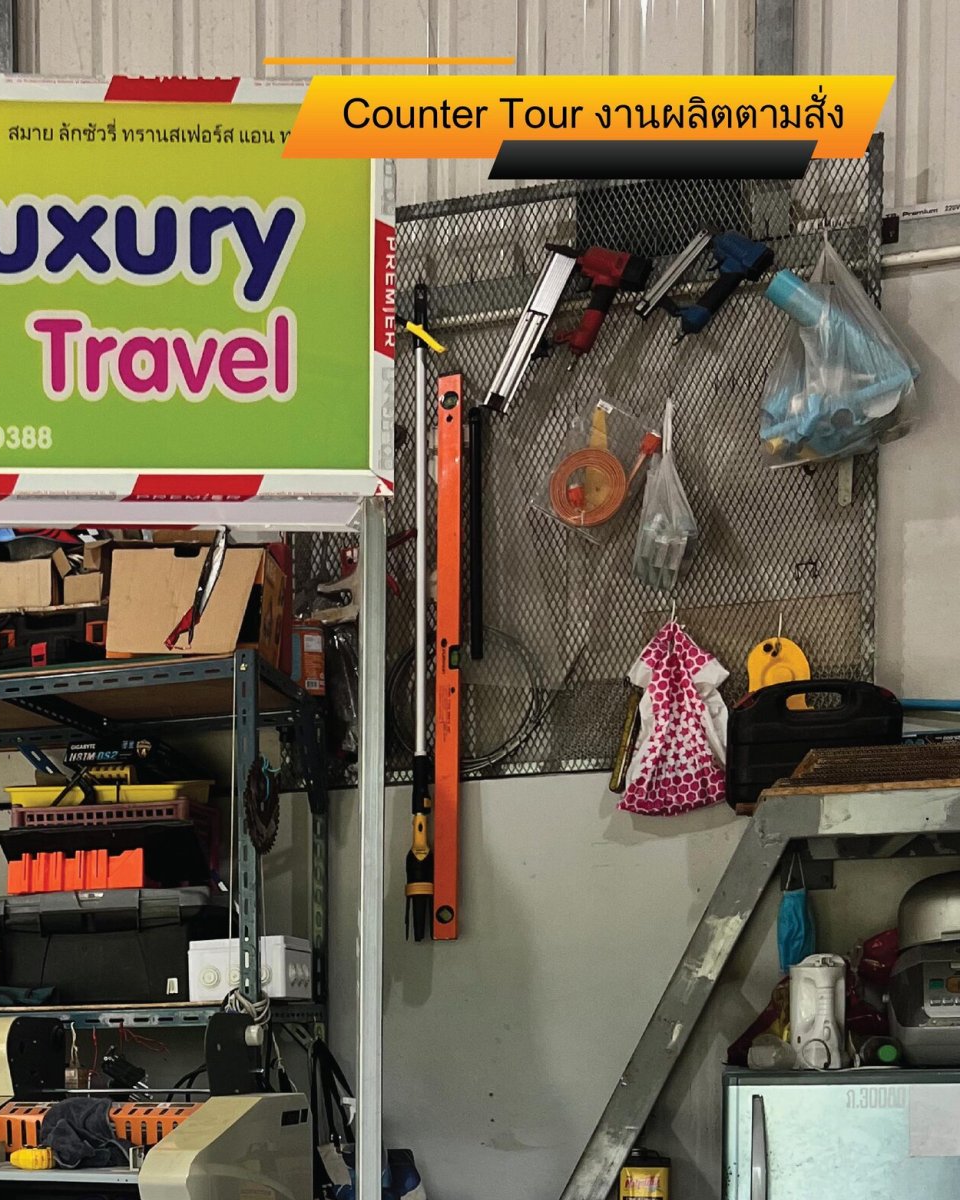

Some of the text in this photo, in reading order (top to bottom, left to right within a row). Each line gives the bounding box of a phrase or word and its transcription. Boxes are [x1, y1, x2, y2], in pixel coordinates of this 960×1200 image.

[8, 125, 53, 141] สมาย
[384, 236, 395, 347] PREMIER
[32, 315, 290, 395] Travel
